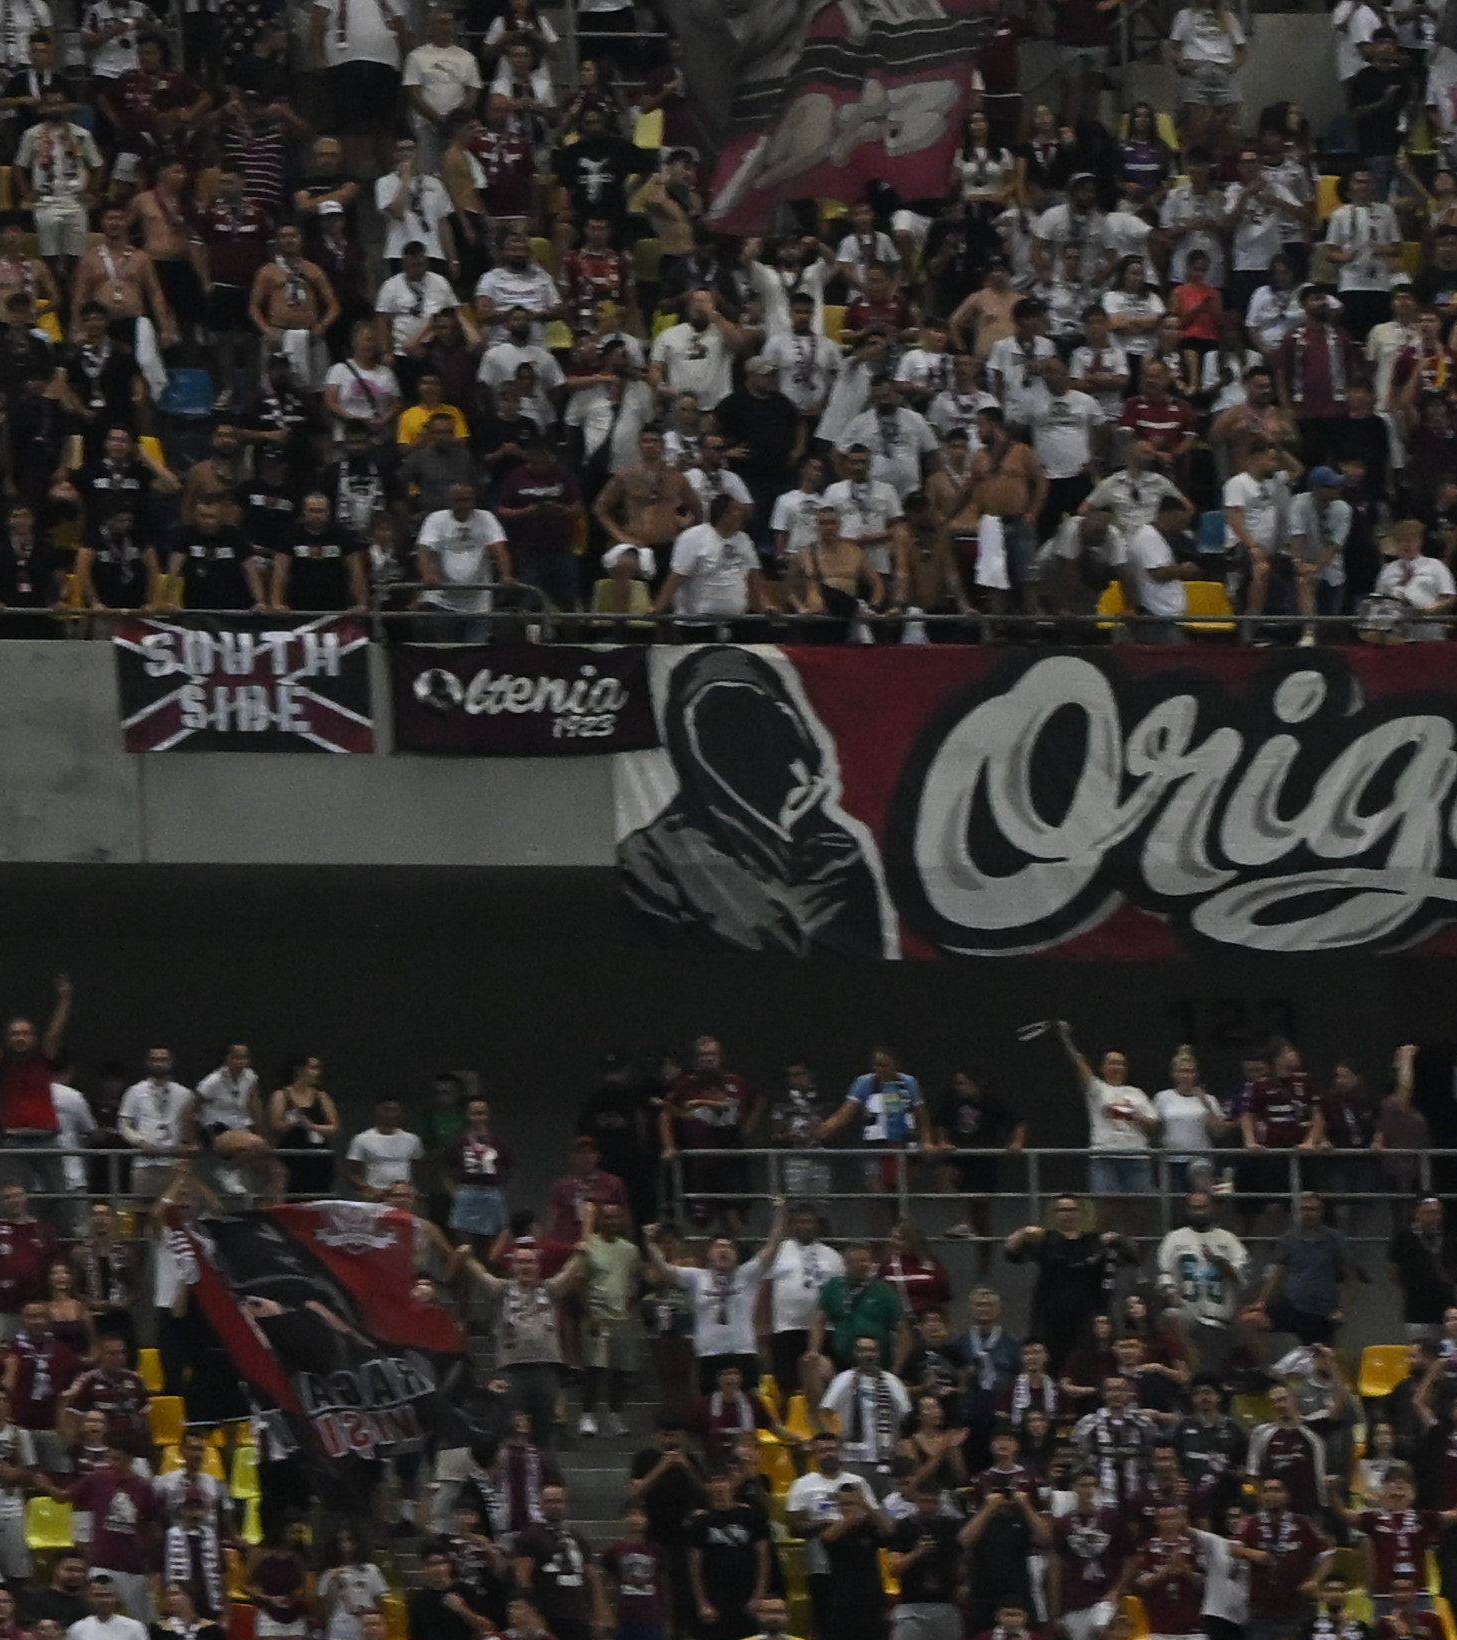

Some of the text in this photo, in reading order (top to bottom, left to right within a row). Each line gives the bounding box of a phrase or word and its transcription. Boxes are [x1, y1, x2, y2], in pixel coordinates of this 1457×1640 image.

[142, 629, 342, 678] SOUTH
[180, 684, 310, 733] SIDE
[551, 714, 620, 738] 1923
